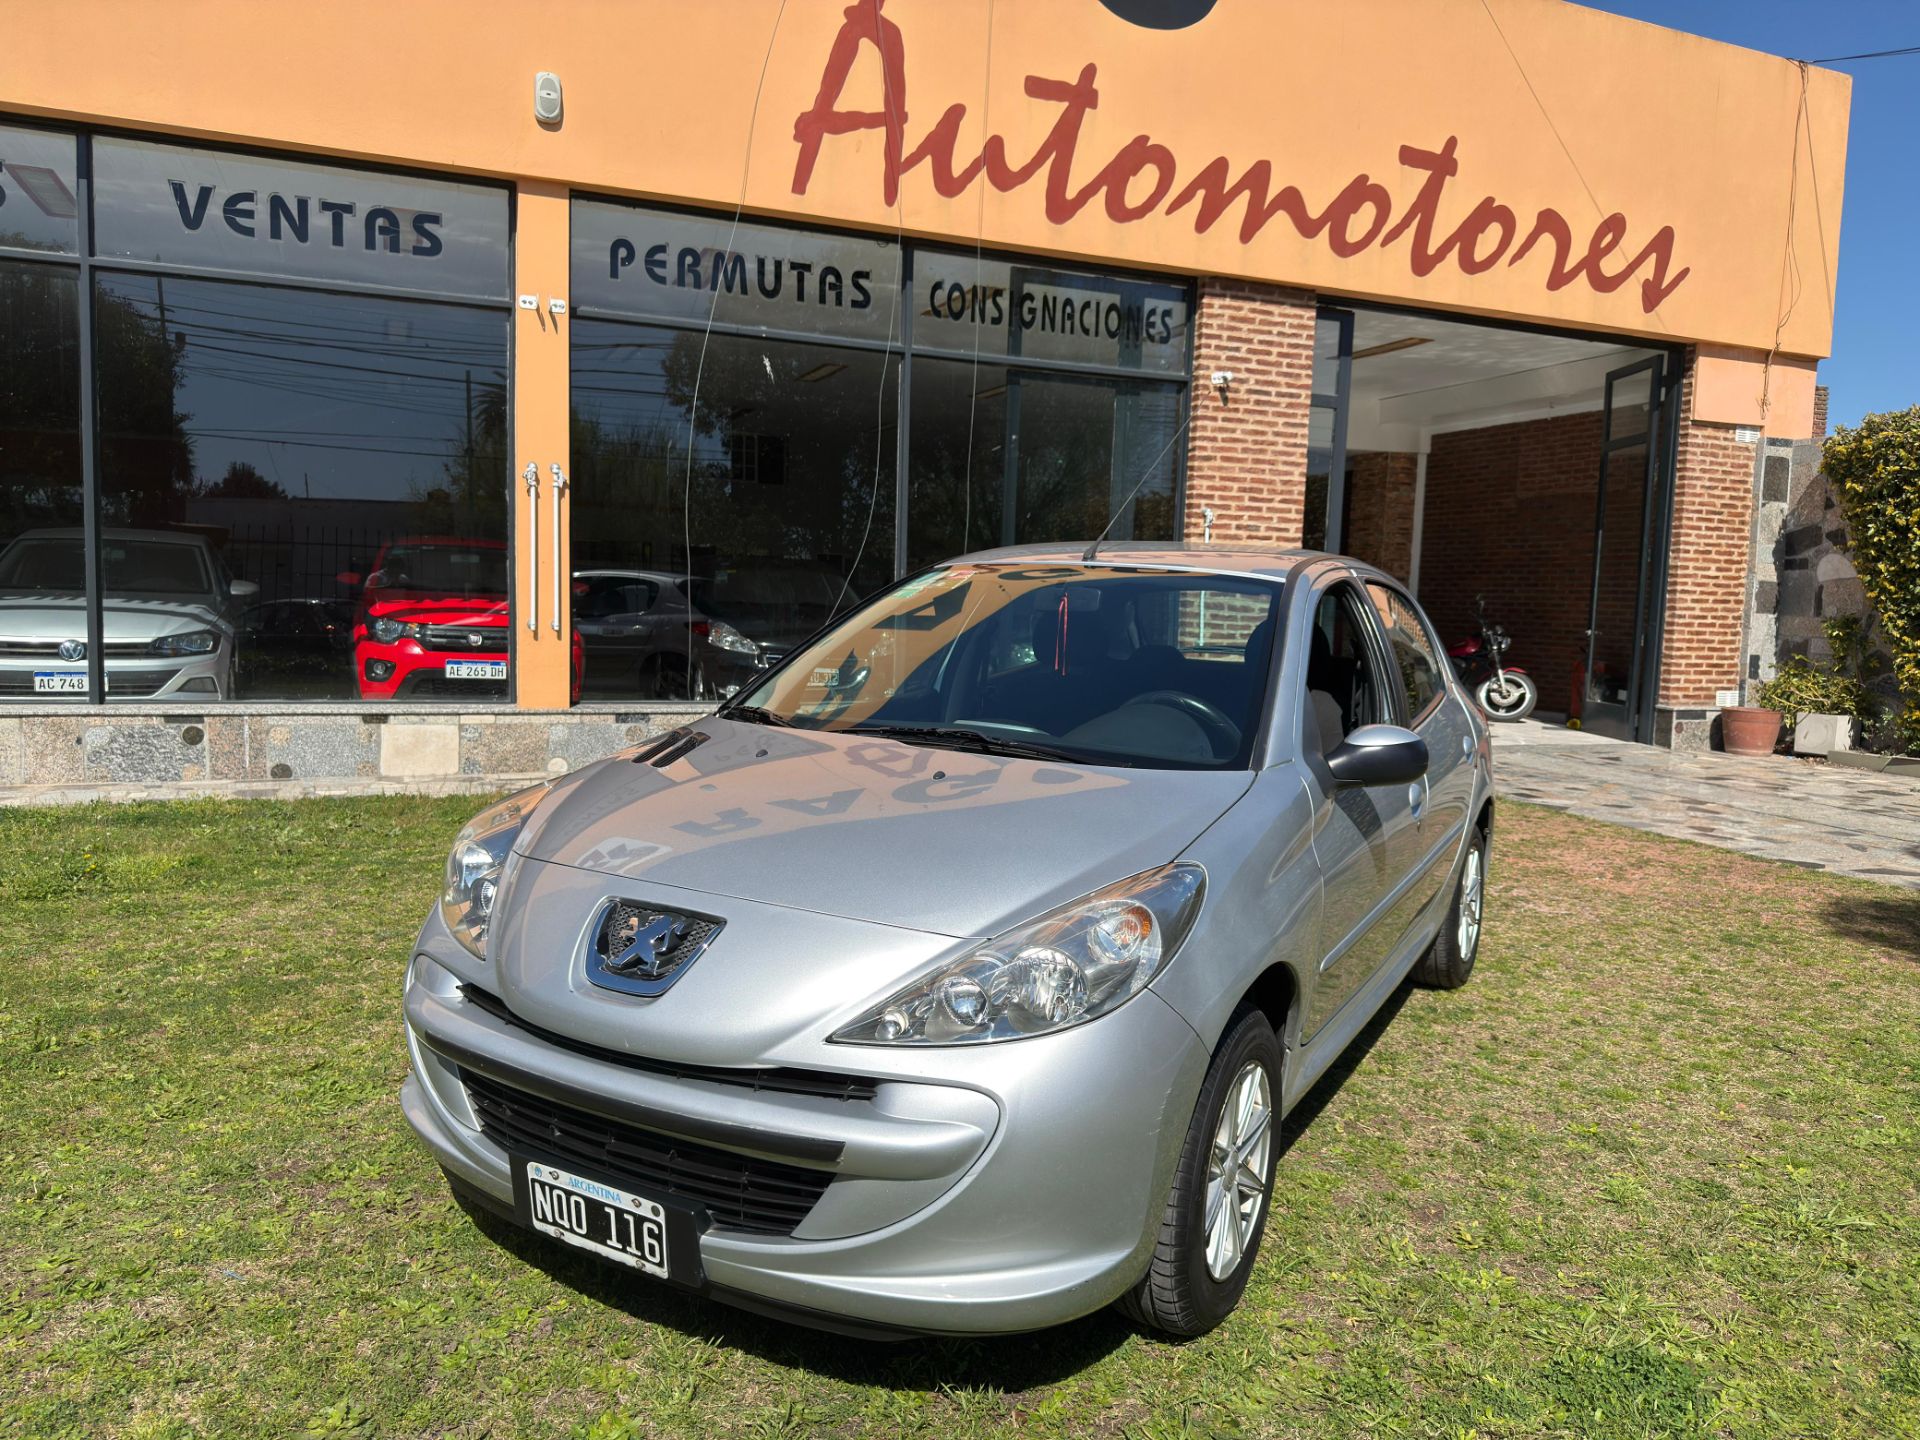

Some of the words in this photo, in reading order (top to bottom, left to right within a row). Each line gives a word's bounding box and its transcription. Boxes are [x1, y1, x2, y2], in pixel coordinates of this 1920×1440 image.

[792, 0, 1690, 314] Automotores
[169, 179, 443, 258] VENTAS
[609, 237, 872, 310] PERMUTAS
[929, 280, 1174, 345] CONSIGNACIONES
[38, 678, 55, 690] AC
[59, 678, 84, 690] 748
[449, 666, 463, 677] AE
[466, 666, 487, 677] 265
[491, 667, 504, 677] DH
[534, 1182, 588, 1235] NQO
[604, 1206, 661, 1264] 116
[567, 1177, 622, 1203] ARGENTINA
